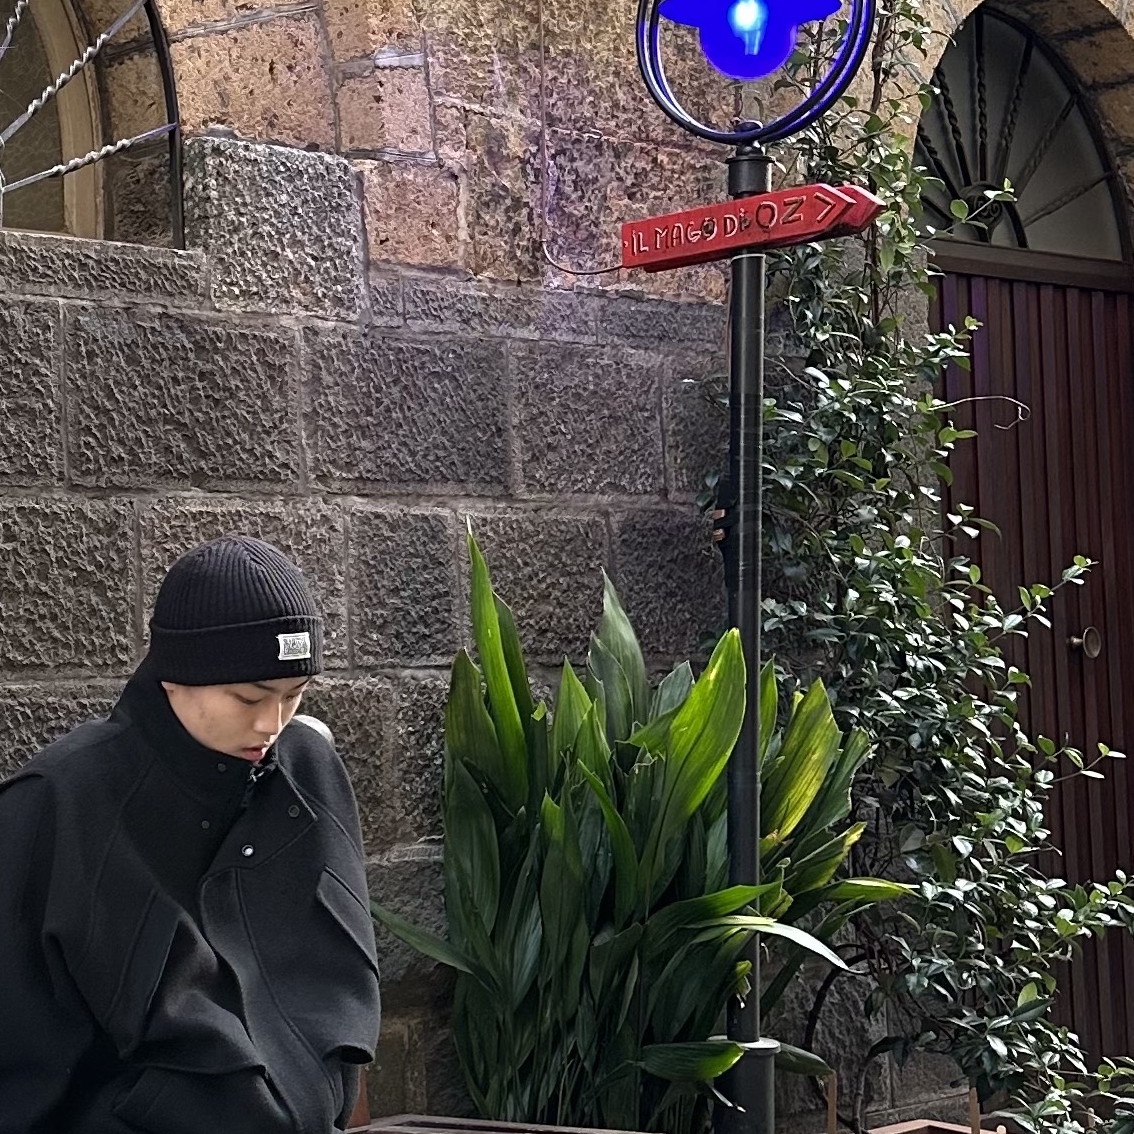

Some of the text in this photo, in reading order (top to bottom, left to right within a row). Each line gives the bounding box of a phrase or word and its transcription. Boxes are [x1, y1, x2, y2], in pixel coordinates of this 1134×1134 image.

[631, 230, 649, 256] IL
[654, 217, 717, 250] MAGO
[755, 196, 807, 229] OZ
